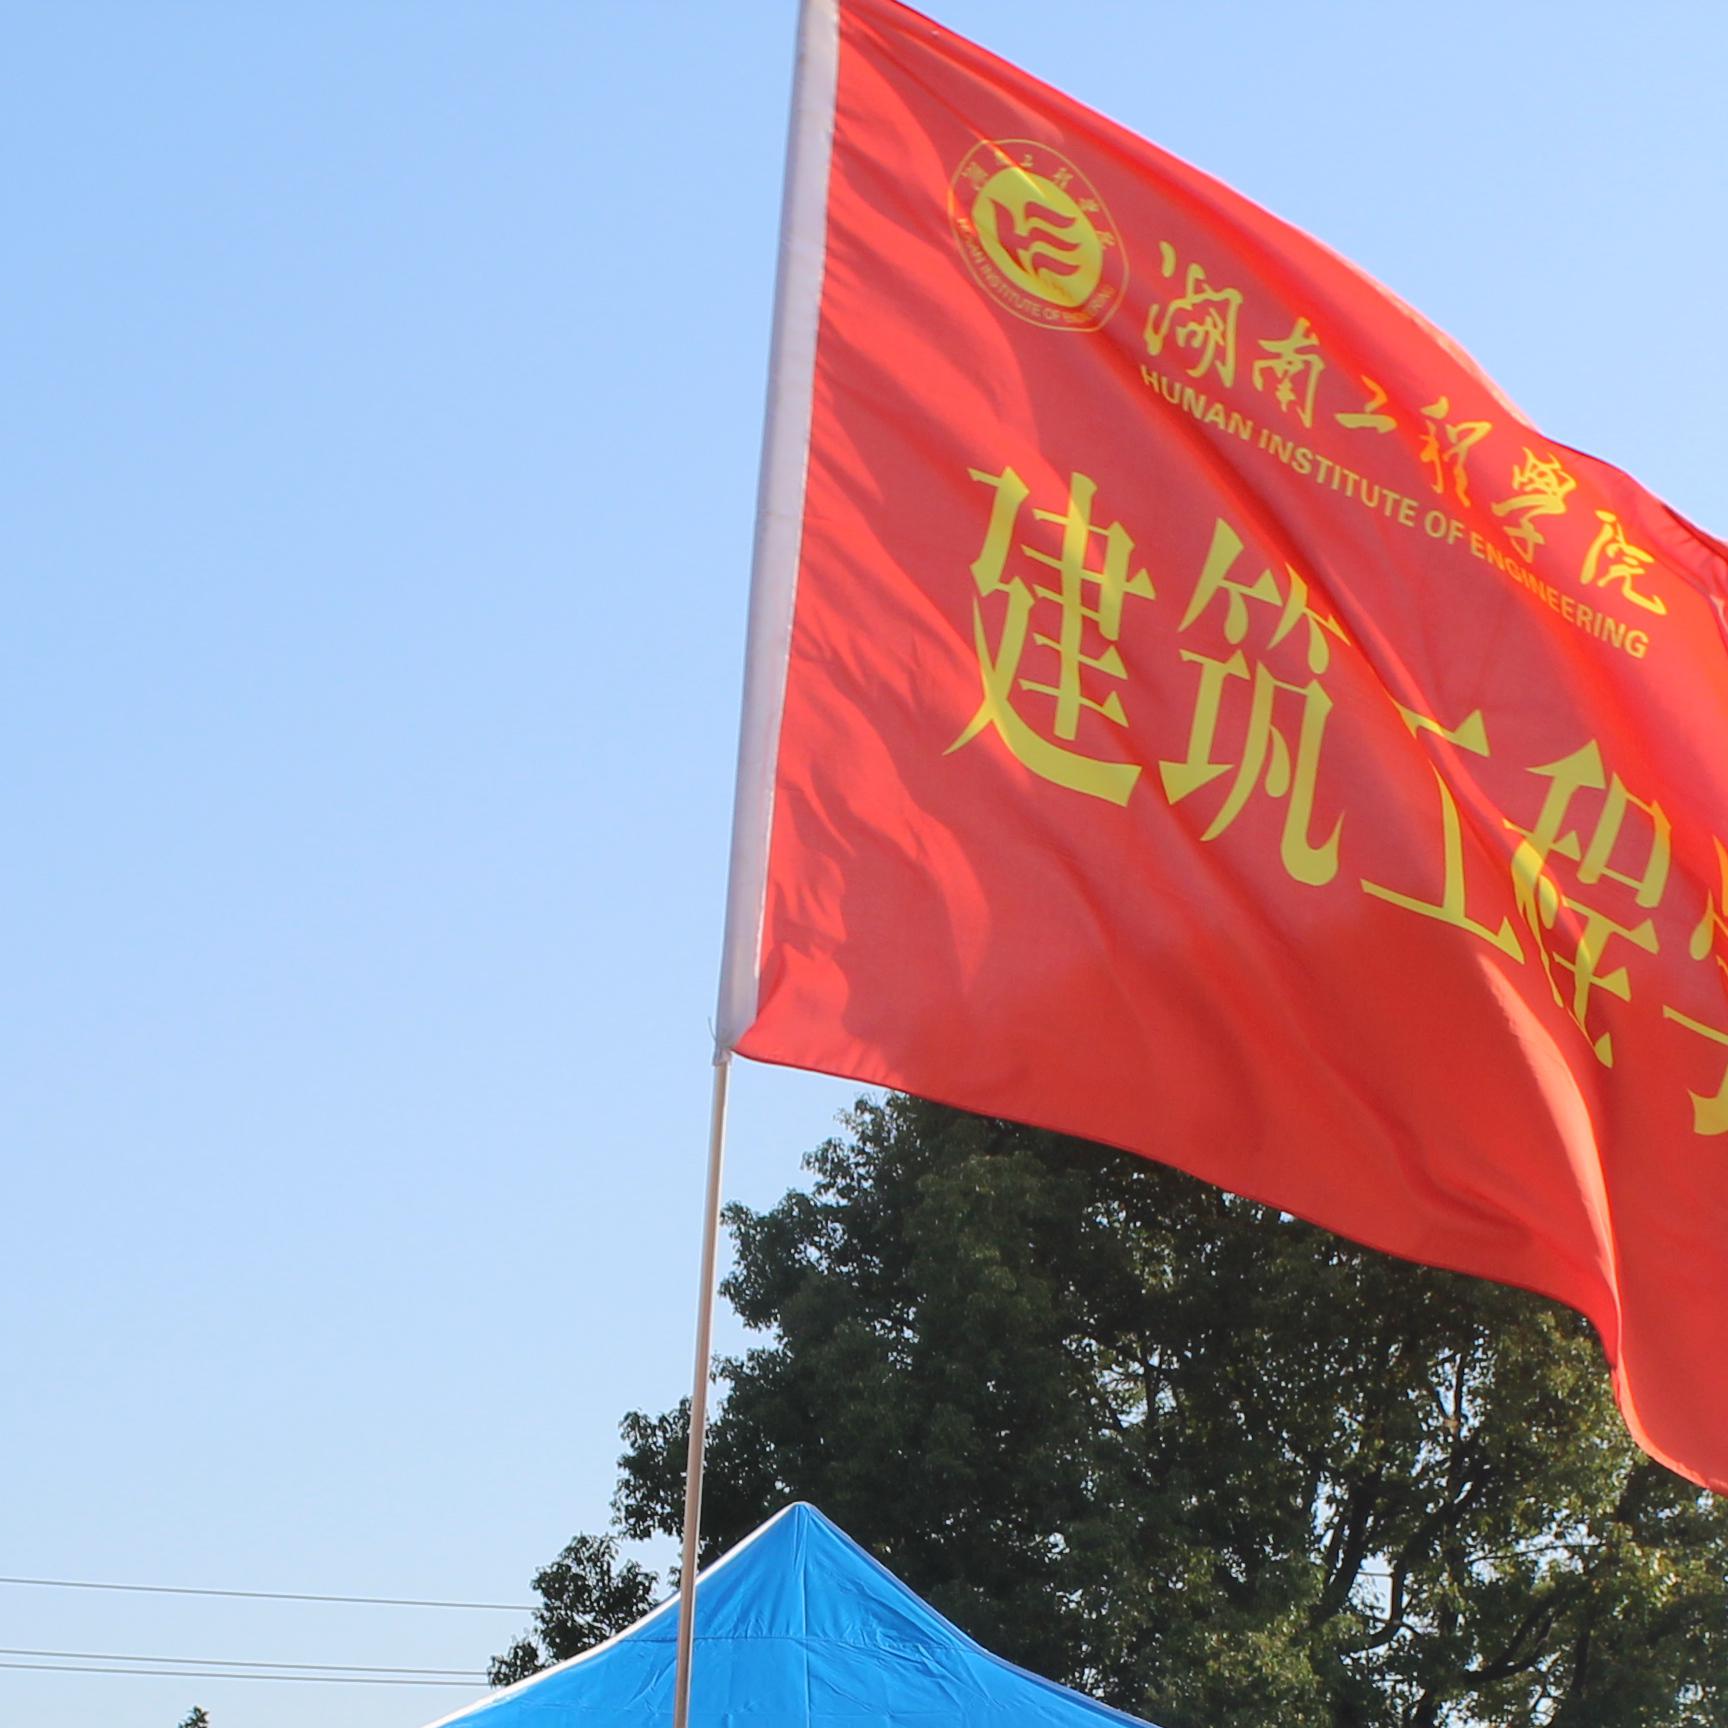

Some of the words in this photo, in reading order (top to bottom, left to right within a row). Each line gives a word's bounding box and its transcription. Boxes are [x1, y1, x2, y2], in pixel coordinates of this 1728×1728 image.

[1140, 363, 1256, 443] HUNAN
[1258, 428, 1417, 527] INSTITUTE
[1423, 509, 1466, 545] OF
[1470, 530, 1650, 660] ENGINEERING
